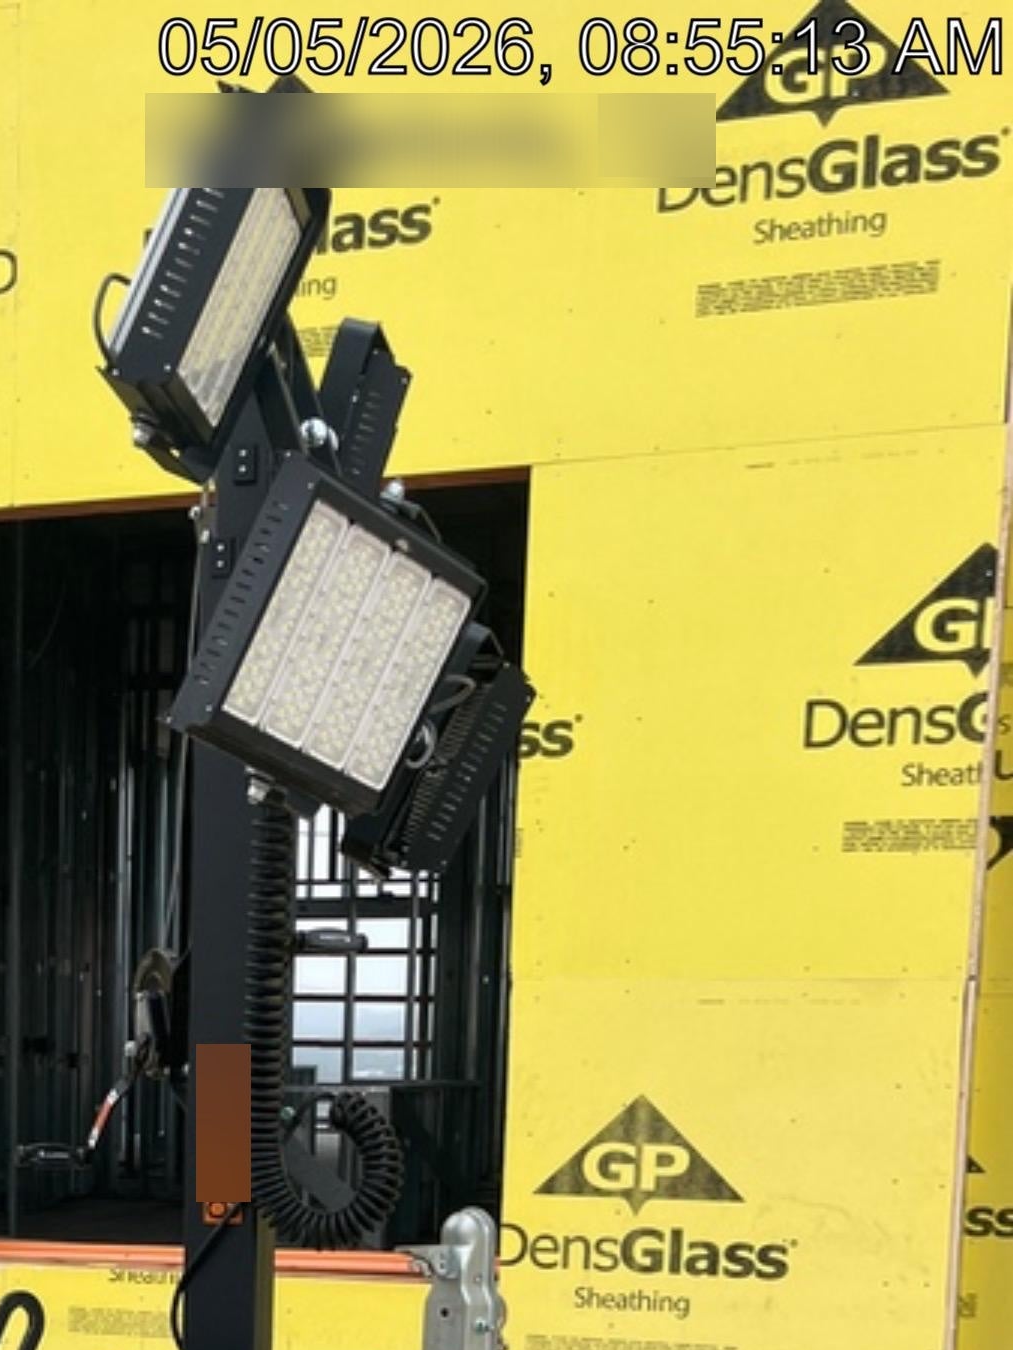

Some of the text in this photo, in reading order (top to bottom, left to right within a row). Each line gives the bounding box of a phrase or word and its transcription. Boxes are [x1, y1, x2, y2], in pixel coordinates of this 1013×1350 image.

[764, 41, 886, 103] GP
[657, 134, 1001, 213] ensGlass
[754, 210, 887, 244] Sheathing
[582, 1142, 690, 1192] GP
[500, 1223, 789, 1281] DensGlass
[575, 1287, 690, 1319] Sheathing
